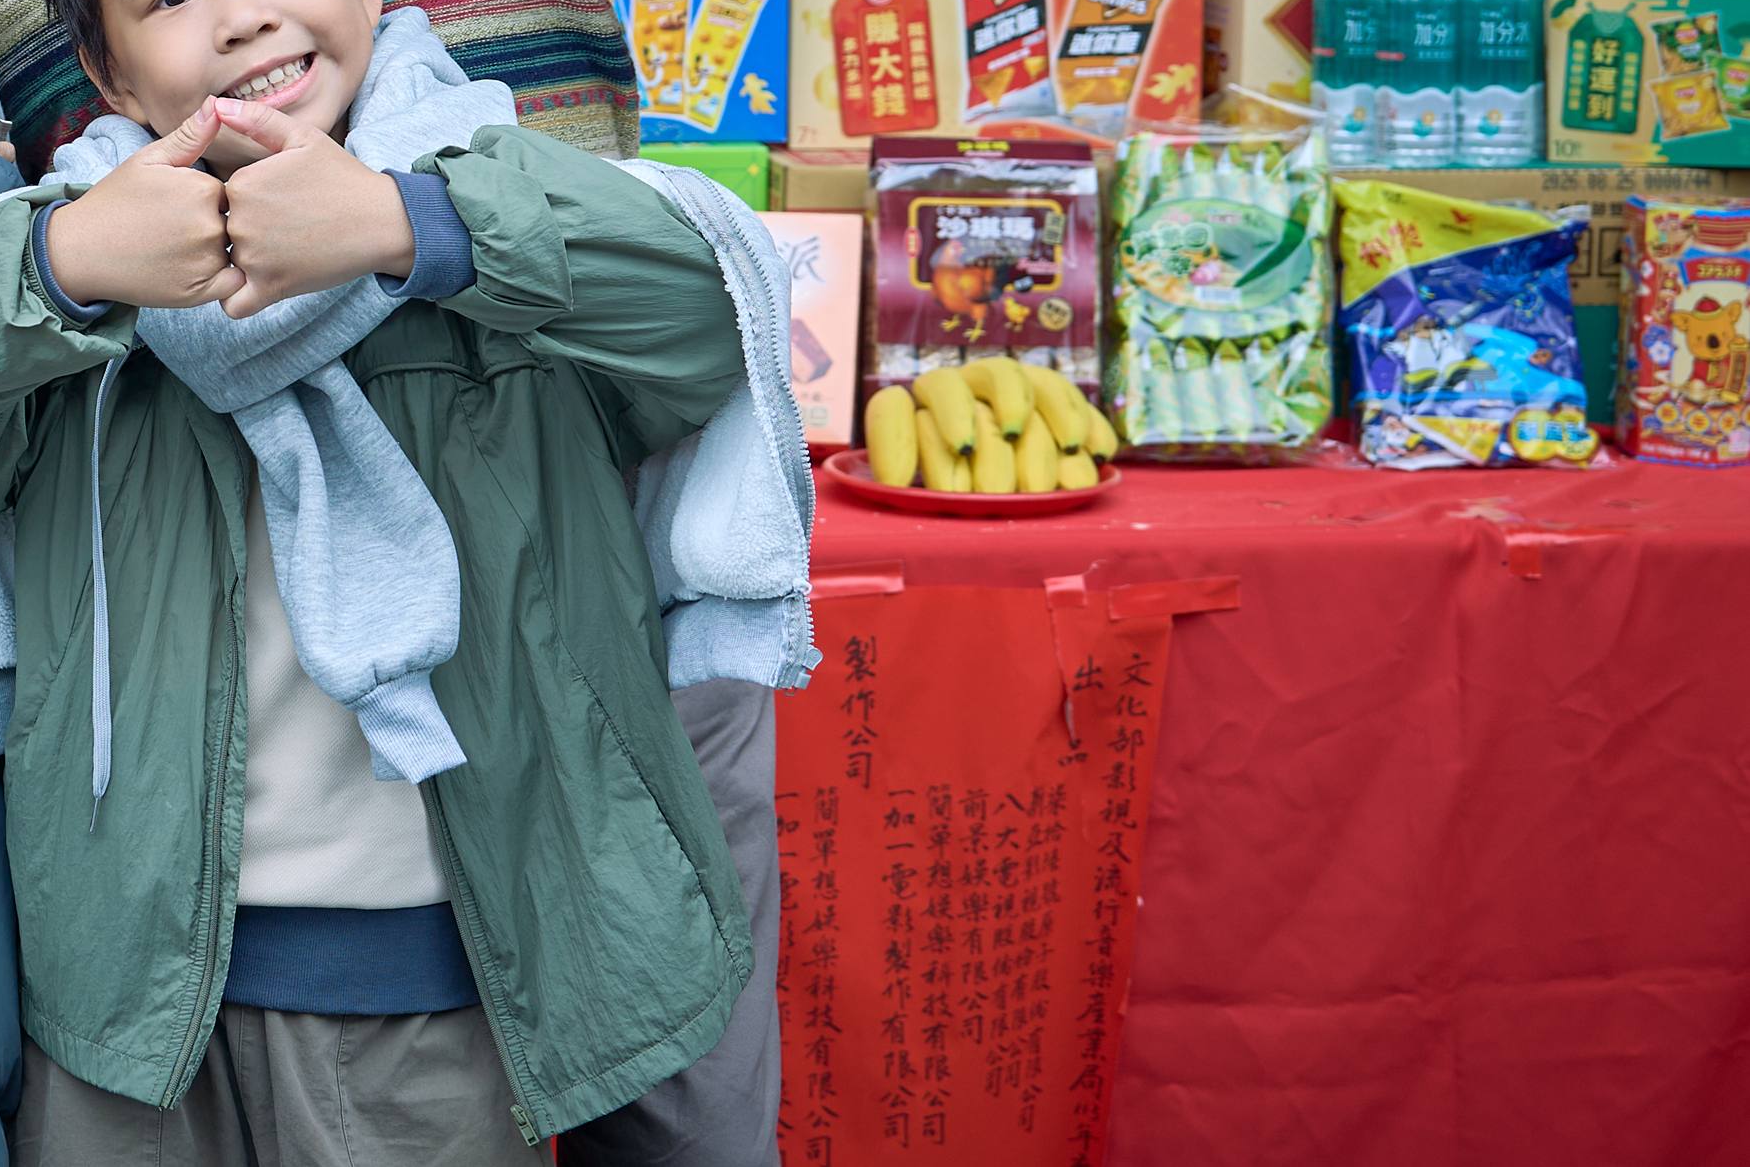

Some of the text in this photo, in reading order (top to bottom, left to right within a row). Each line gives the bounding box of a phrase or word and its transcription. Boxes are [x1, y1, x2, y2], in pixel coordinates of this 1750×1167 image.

[1585, 37, 1620, 120] 好運到
[935, 215, 1036, 240] 沙琪瑪
[840, 635, 878, 790] 製作公司
[1057, 654, 1104, 768] 出品
[802, 785, 843, 1167] 簡單想娛樂科技有限公司
[882, 789, 918, 1149] 一加一電影製作有限公司
[919, 784, 956, 1146] 簡單想娛樂科技有限公司
[957, 789, 991, 1046] 前景娛樂有限公司
[985, 791, 1026, 1098] 八大電視股份有限公司
